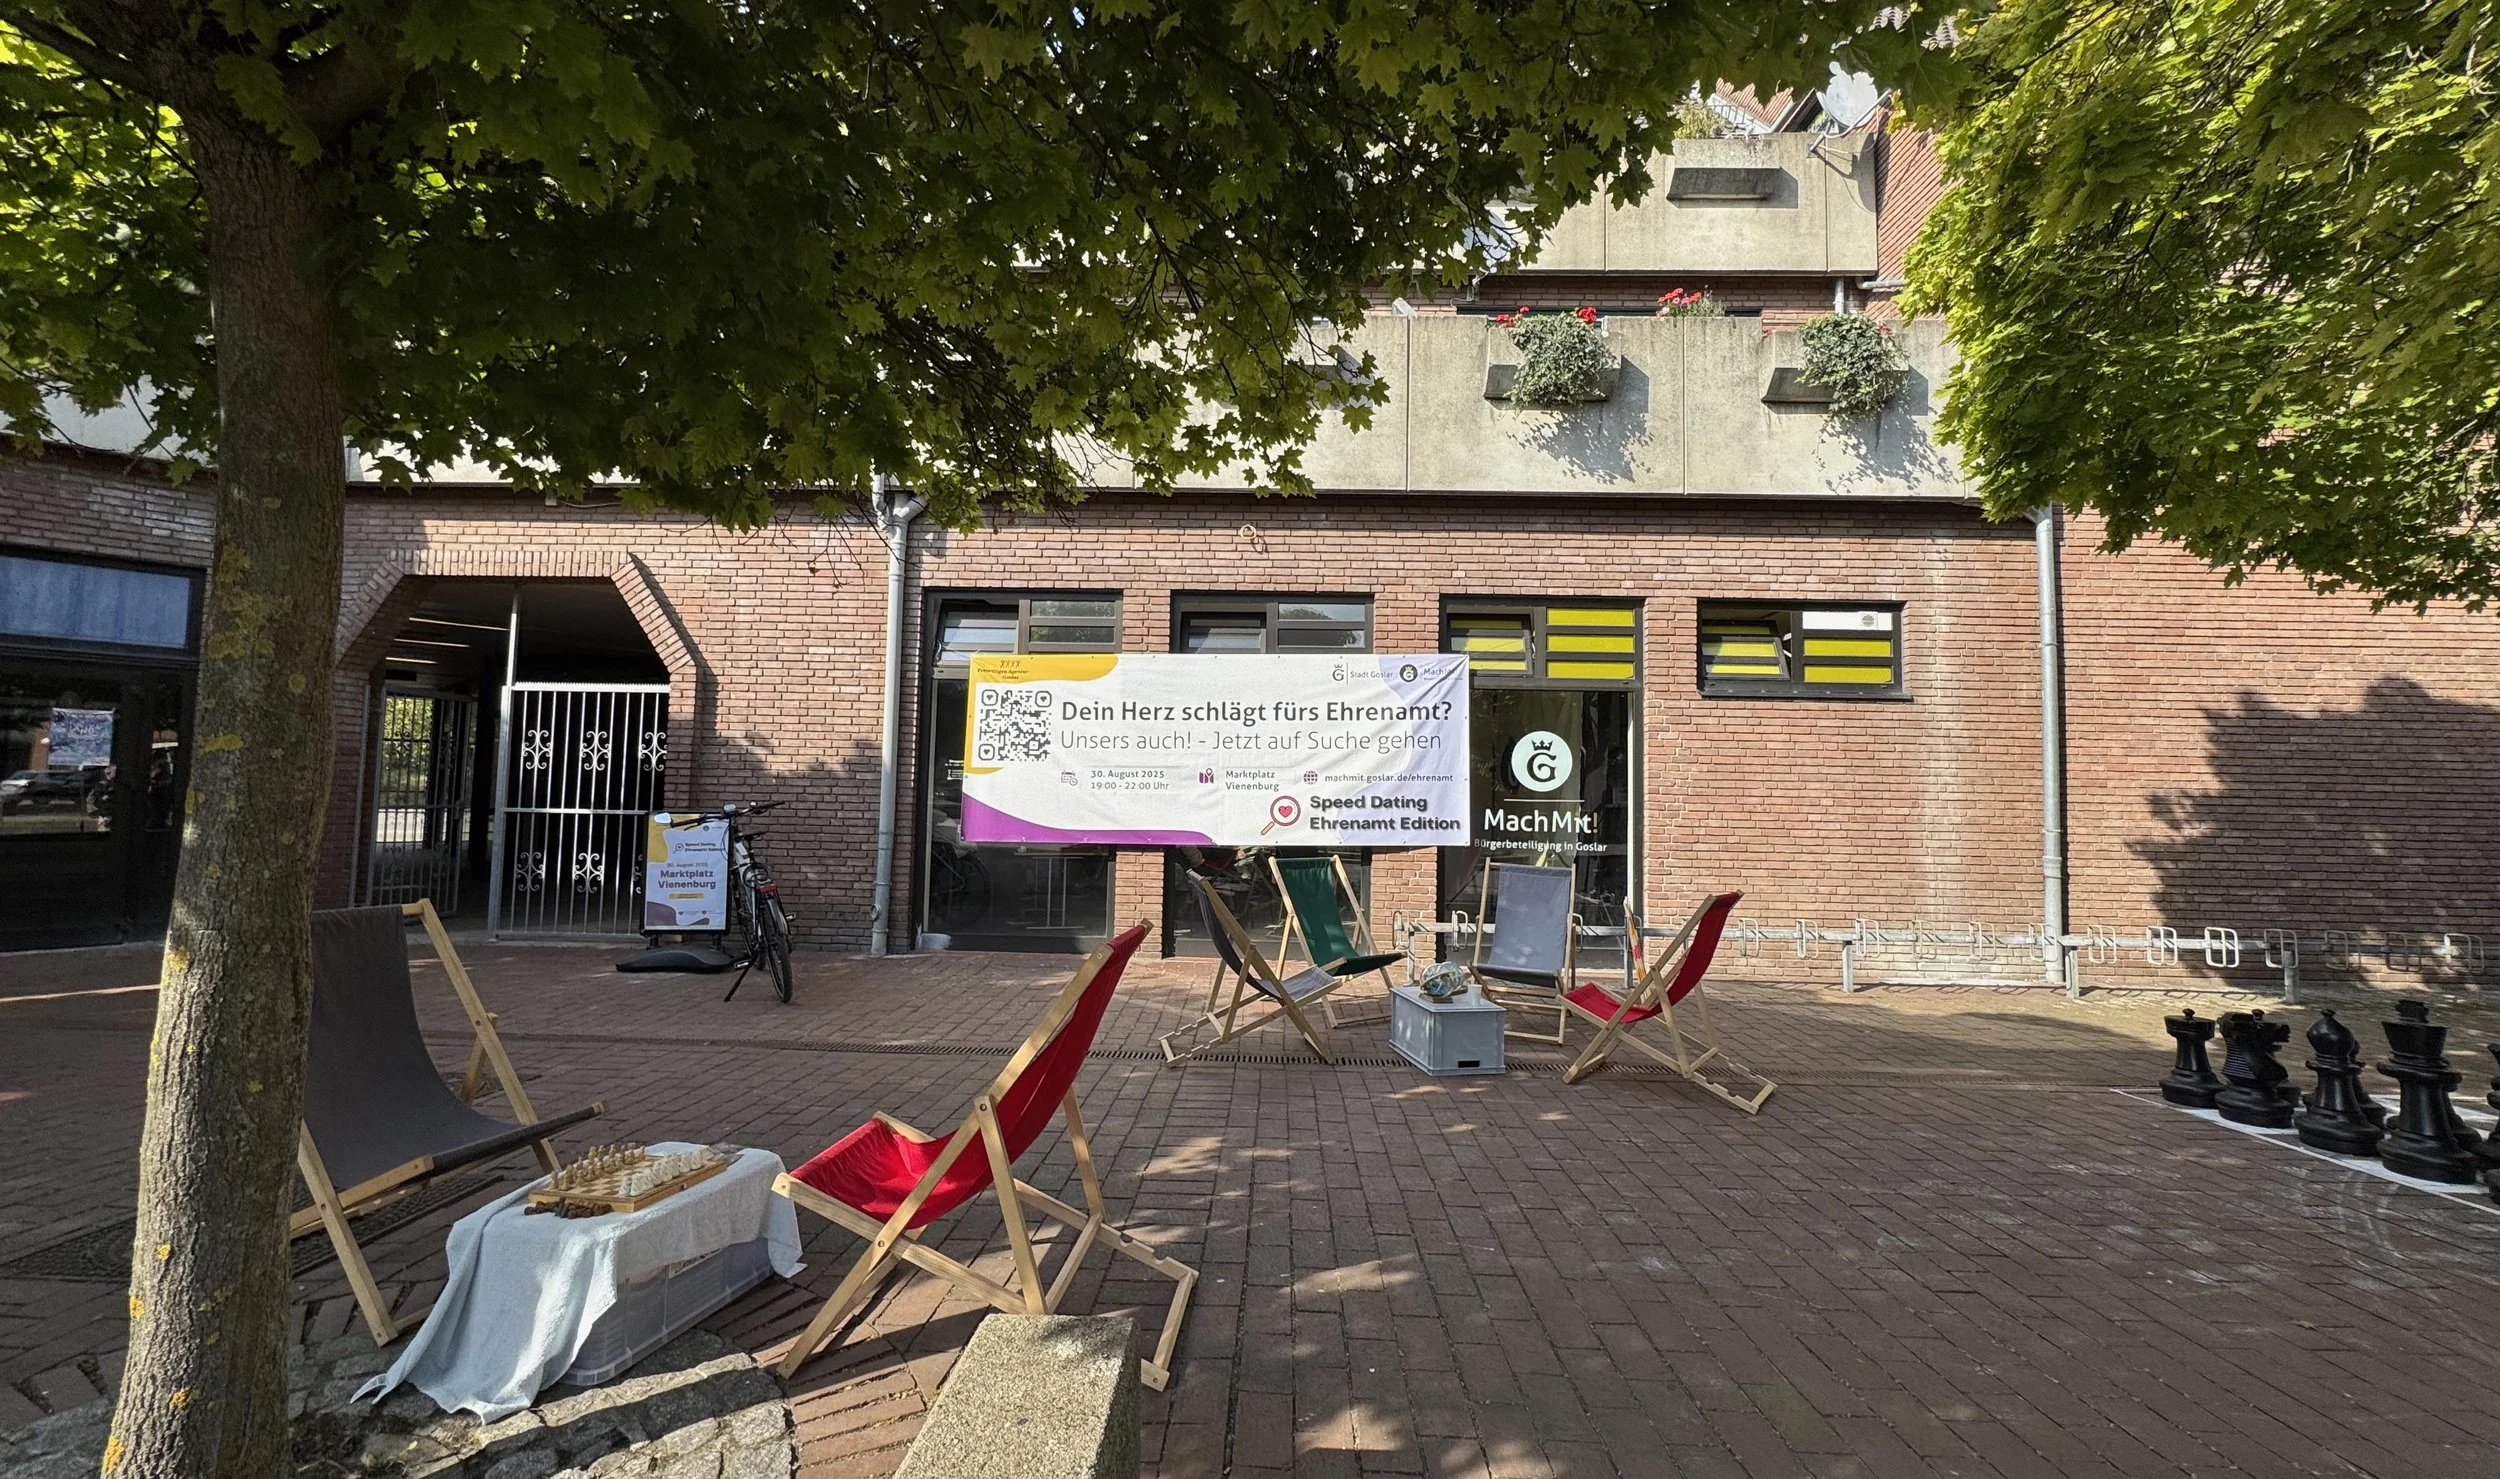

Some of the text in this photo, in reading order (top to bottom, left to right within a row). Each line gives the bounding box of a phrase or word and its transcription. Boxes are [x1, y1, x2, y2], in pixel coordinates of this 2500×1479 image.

[1062, 701, 1452, 728] Dein Herz schlägt fürs Ehrenamt?
[1061, 730, 1130, 749] Unsers
[1136, 730, 1191, 749] auch!
[1212, 731, 1261, 750] Jetzt
[1268, 731, 1302, 749] auf
[1308, 731, 1371, 750] Suche
[1378, 731, 1441, 755] gehen
[1090, 769, 1165, 780] 30. August 2025
[1225, 770, 1276, 780] Marktplatz
[1324, 773, 1454, 784] machmit.goslar.de/ehrenamt
[1153, 781, 1170, 790] Uhr
[1225, 781, 1280, 792] Vienenburg
[1310, 795, 1428, 812] Speed Dating
[1310, 817, 1461, 830] Ehrenamt Edition
[1483, 808, 1598, 834] MachMit!
[1474, 838, 1608, 852] Bürgerbeteiligung in Goslar
[660, 870, 714, 879] Marktplatz
[658, 880, 717, 890] Vienenburg
